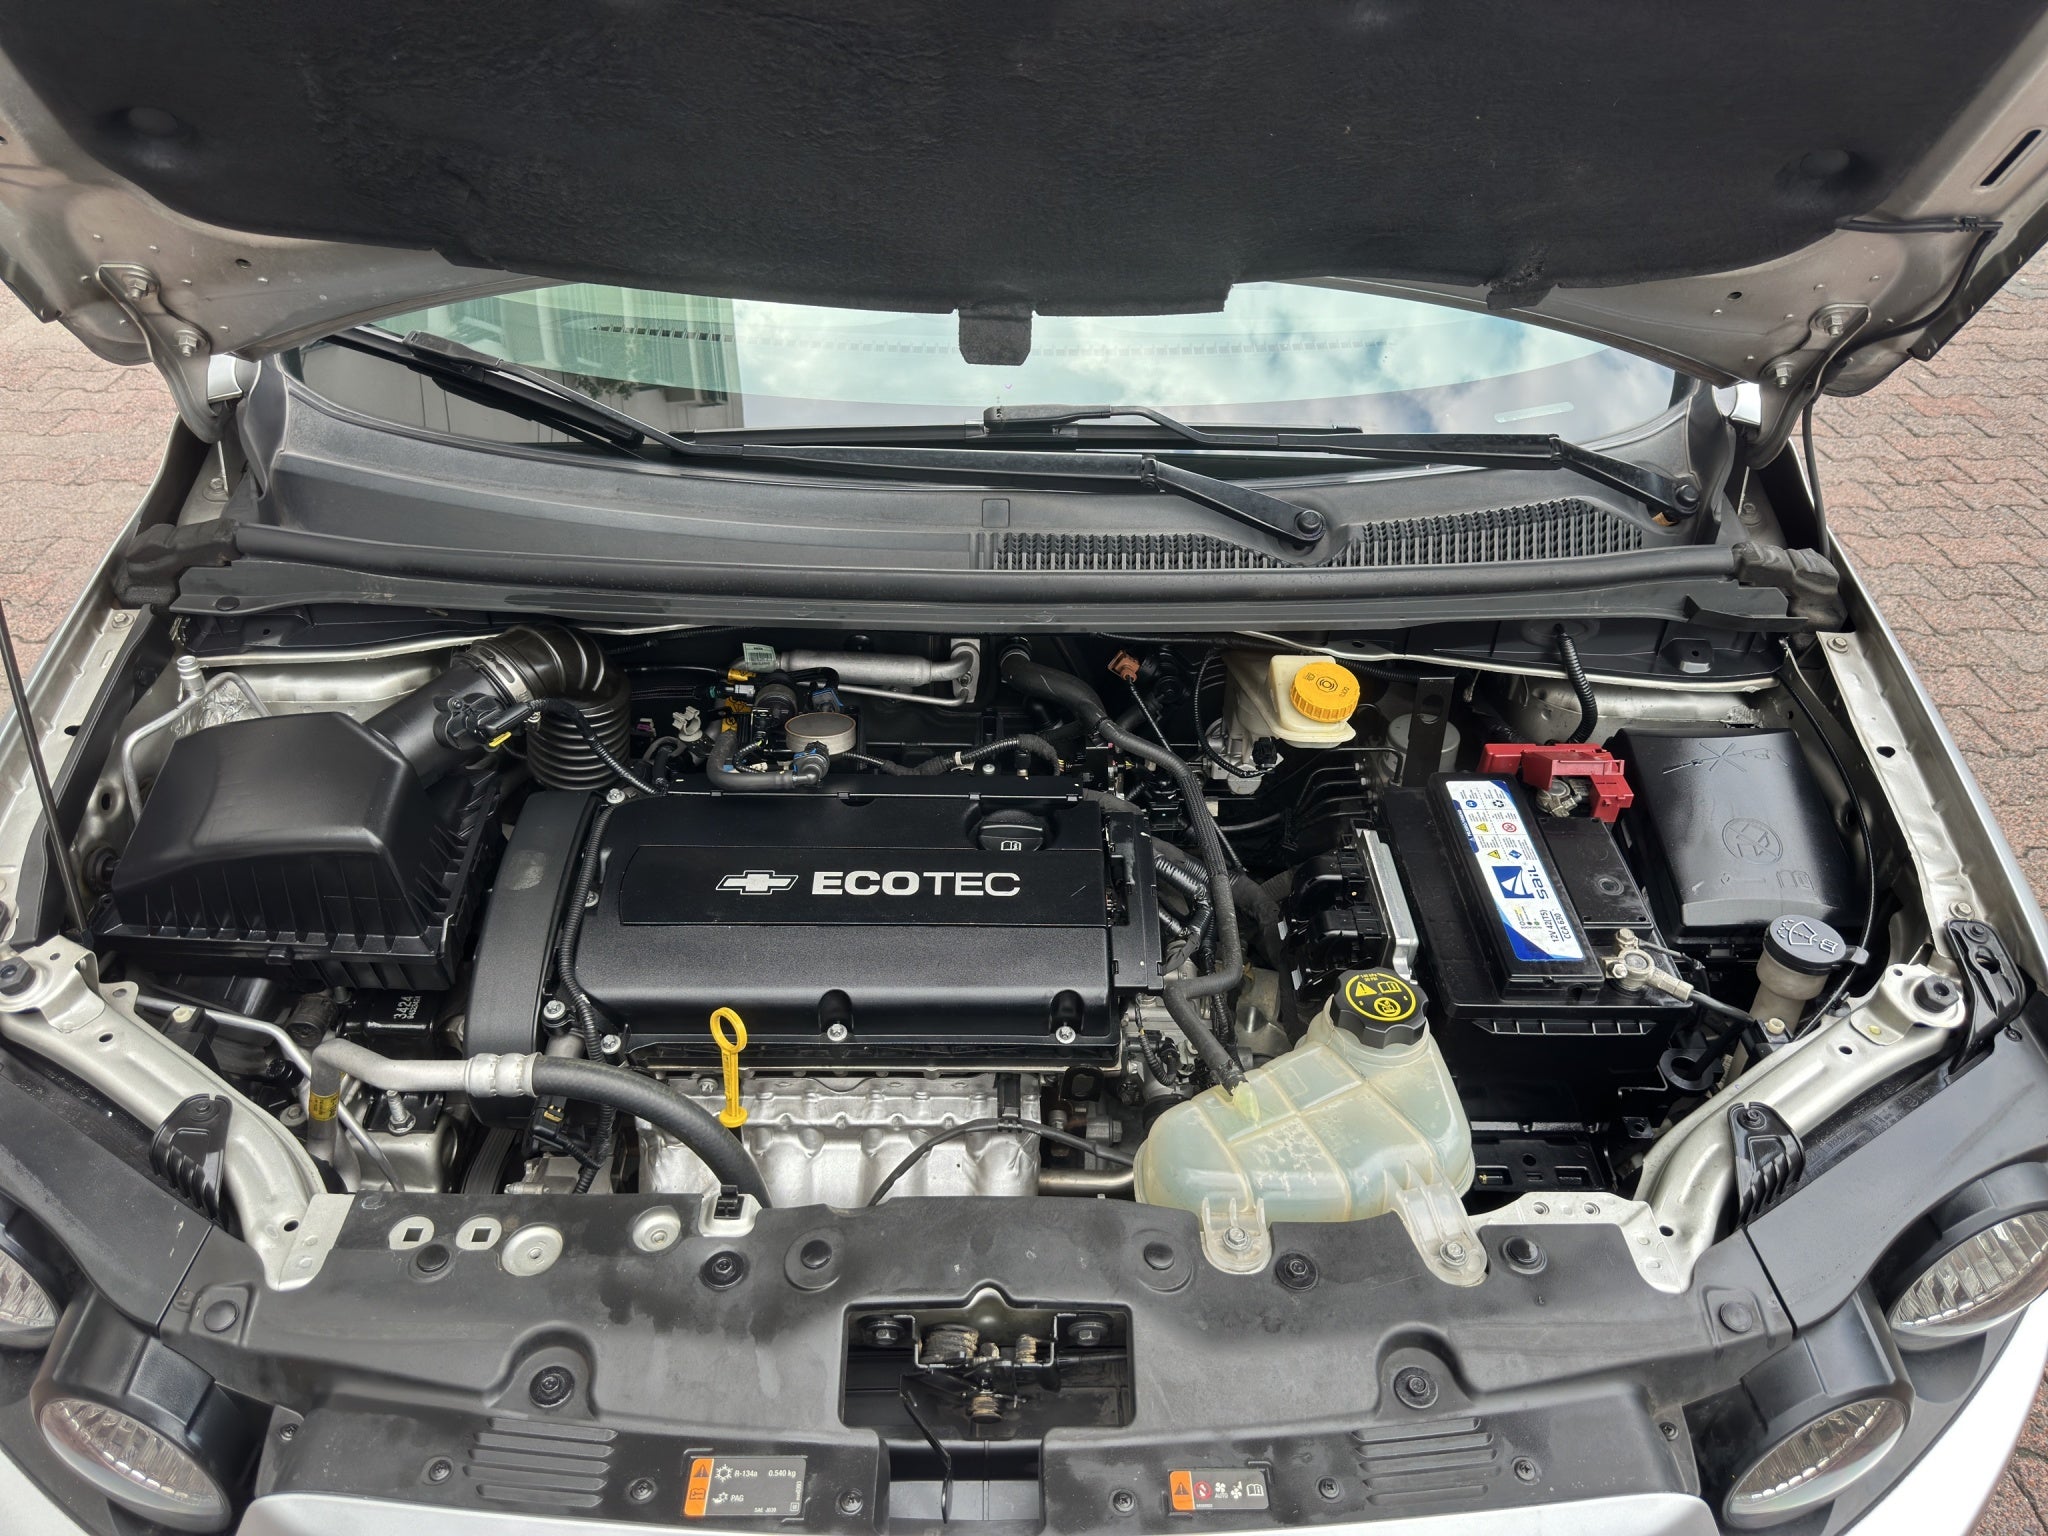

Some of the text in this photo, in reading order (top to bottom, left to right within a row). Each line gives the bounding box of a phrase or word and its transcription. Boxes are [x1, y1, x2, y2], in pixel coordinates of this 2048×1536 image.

[812, 870, 1021, 897] ECOTEC
[1554, 912, 1571, 939] CCA 630
[1548, 930, 1559, 942] 12V
[393, 996, 414, 1019] 3424
[734, 1469, 797, 1479] R-134a 0.540 kg
[730, 1494, 744, 1502] PAG
